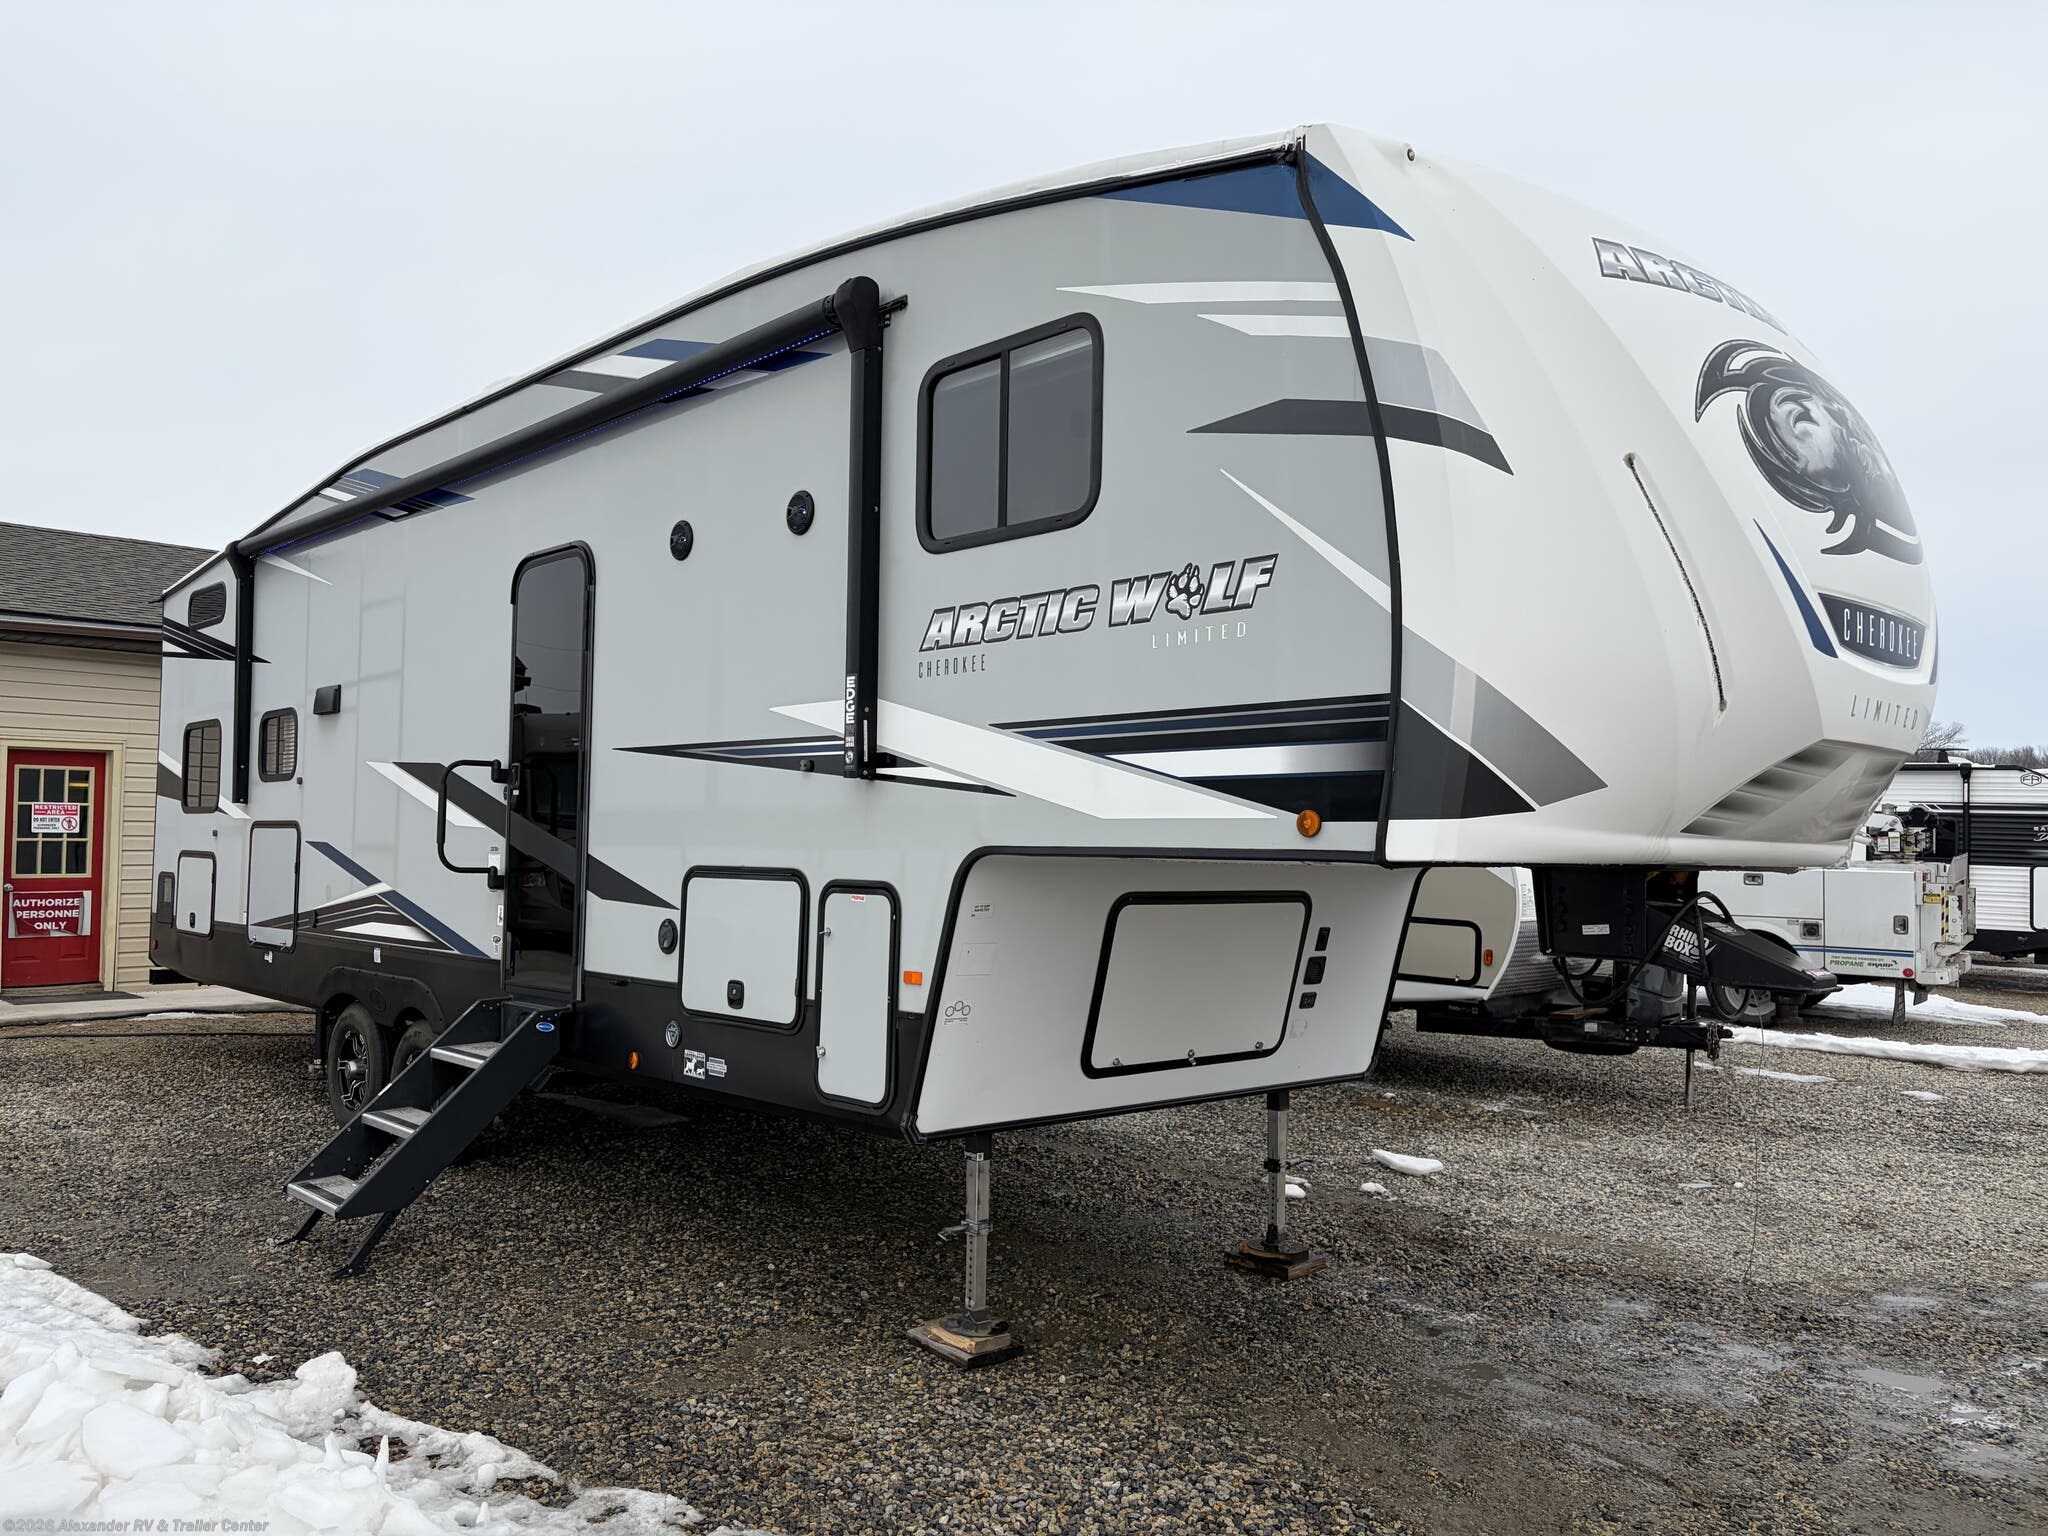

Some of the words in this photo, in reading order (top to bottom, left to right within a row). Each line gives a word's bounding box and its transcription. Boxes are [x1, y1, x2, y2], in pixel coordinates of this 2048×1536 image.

[1592, 237, 1788, 335] ARCTI
[918, 584, 1100, 652] ARCTIC
[1152, 622, 1246, 649] LIMITED
[1844, 608, 1918, 660] CHEROKEE
[918, 654, 986, 679] CHEROKEE
[845, 676, 856, 724] EDGE
[1850, 695, 1919, 730] LIMITED
[34, 921, 67, 930] ONLY
[1663, 935, 1694, 956] BOX
[1830, 959, 1864, 968] PROPANE
